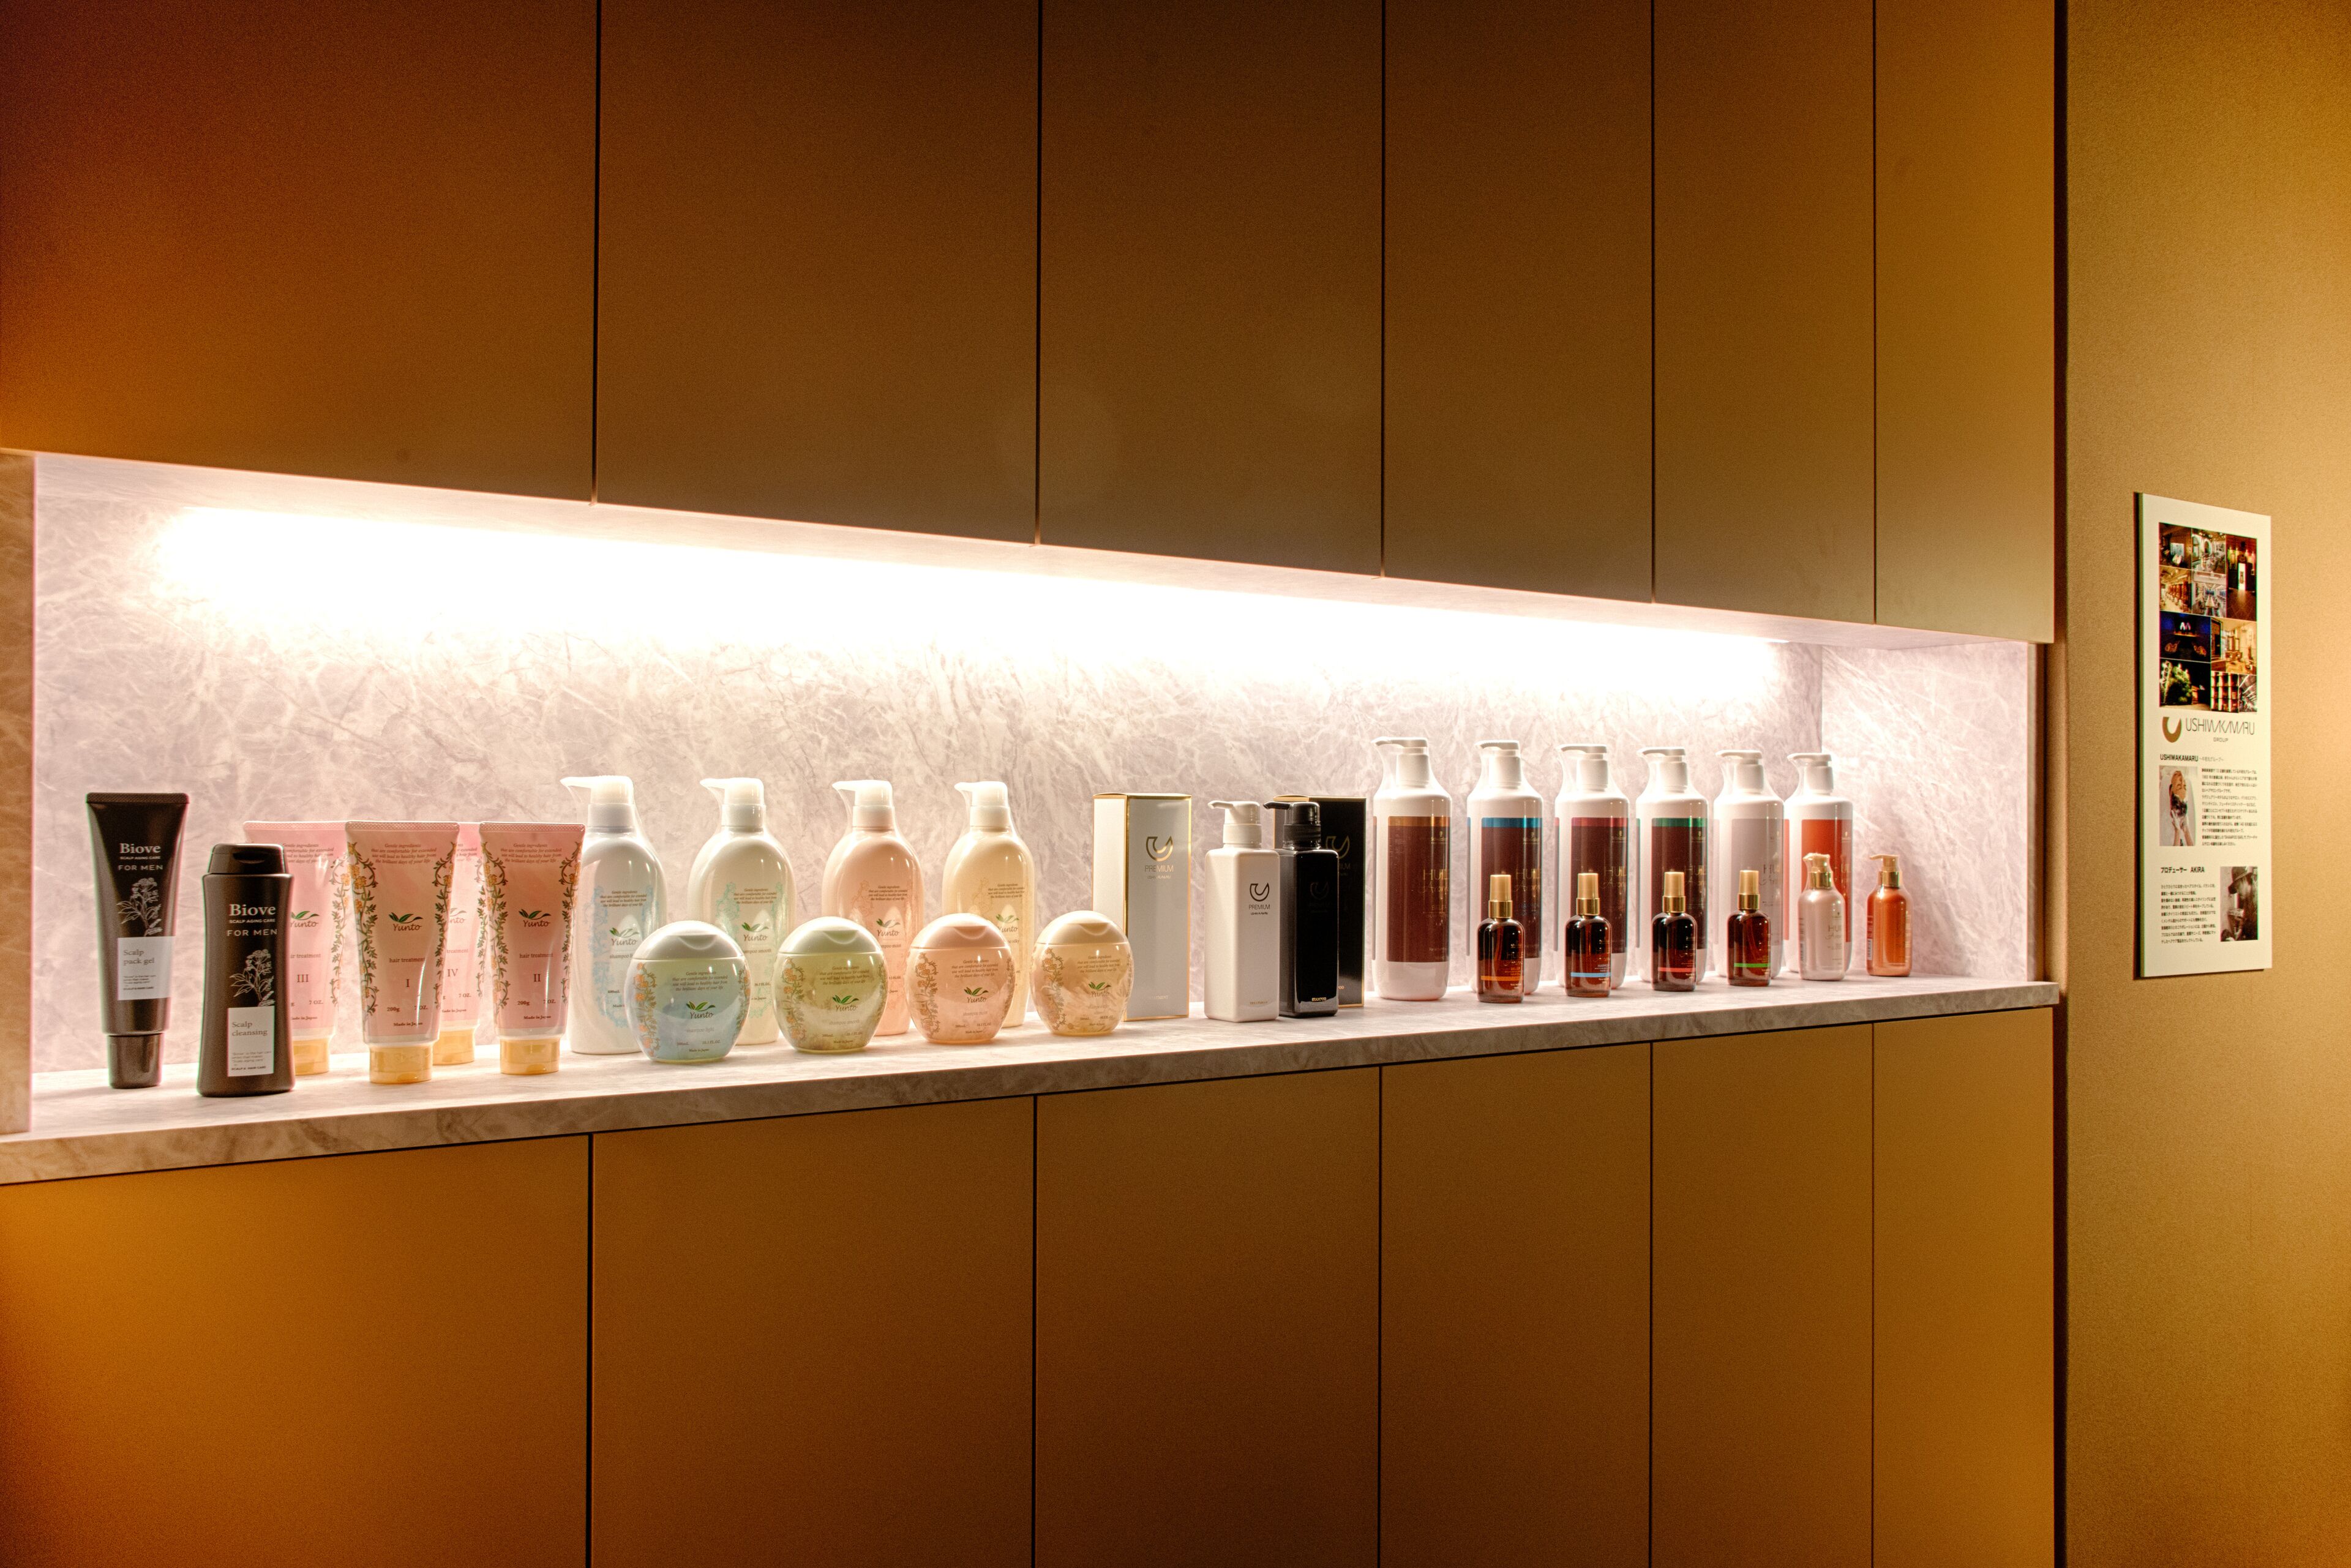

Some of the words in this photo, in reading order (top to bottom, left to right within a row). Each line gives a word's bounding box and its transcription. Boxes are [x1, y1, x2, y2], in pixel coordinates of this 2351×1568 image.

[2159, 754, 2199, 762] USHIWAKAMARU
[119, 842, 162, 853] Biove
[228, 904, 277, 917] Biove
[611, 937, 638, 946] Yunto
[143, 957, 155, 966] gel
[447, 968, 459, 977] IV
[296, 973, 309, 983] III
[533, 973, 541, 982] II
[405, 979, 410, 988] I
[690, 1011, 714, 1019] Yunto
